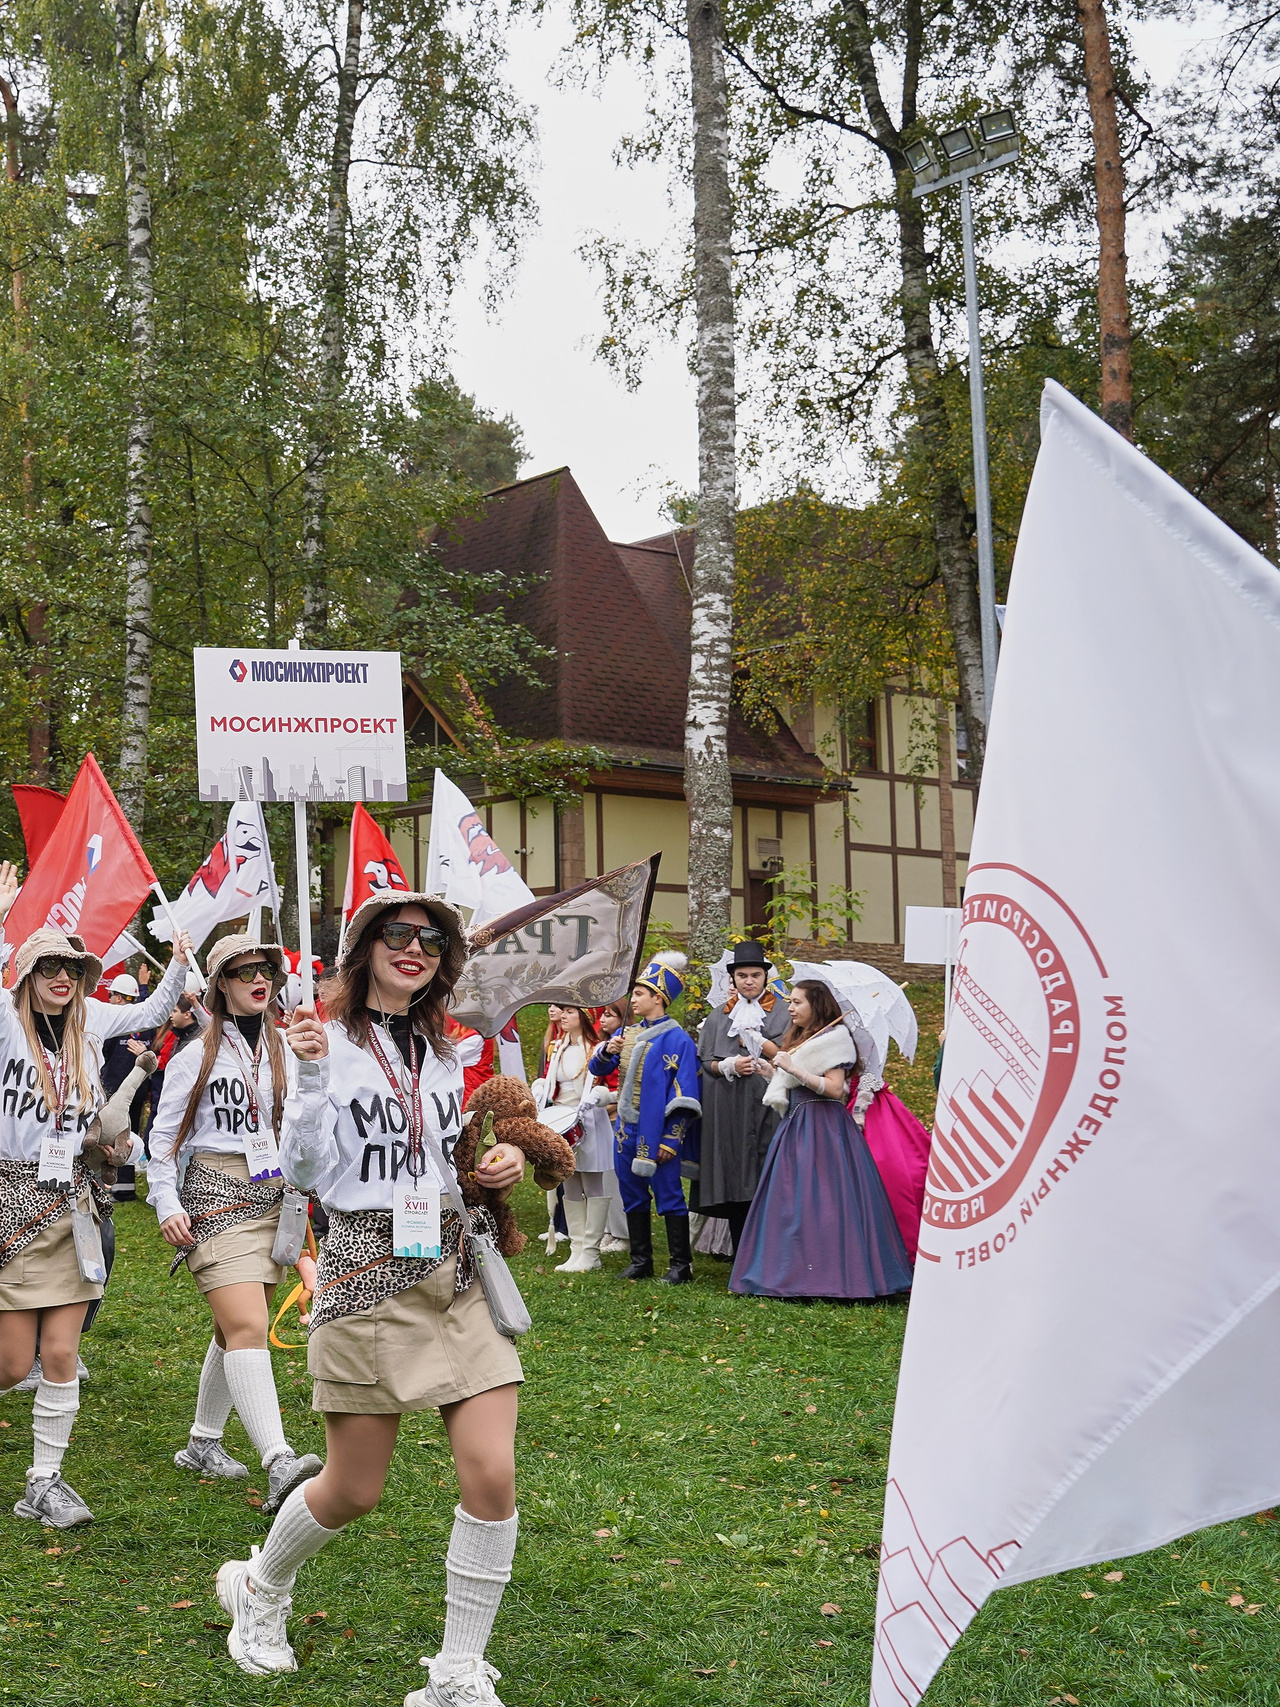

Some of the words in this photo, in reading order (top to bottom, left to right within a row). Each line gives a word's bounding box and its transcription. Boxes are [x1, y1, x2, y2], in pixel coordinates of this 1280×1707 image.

[251, 660, 369, 684] МОСИНЖПРОЕКТ
[209, 715, 398, 734] МОСИНЖПРОЕКТ
[404, 1200, 429, 1211] XVIII
